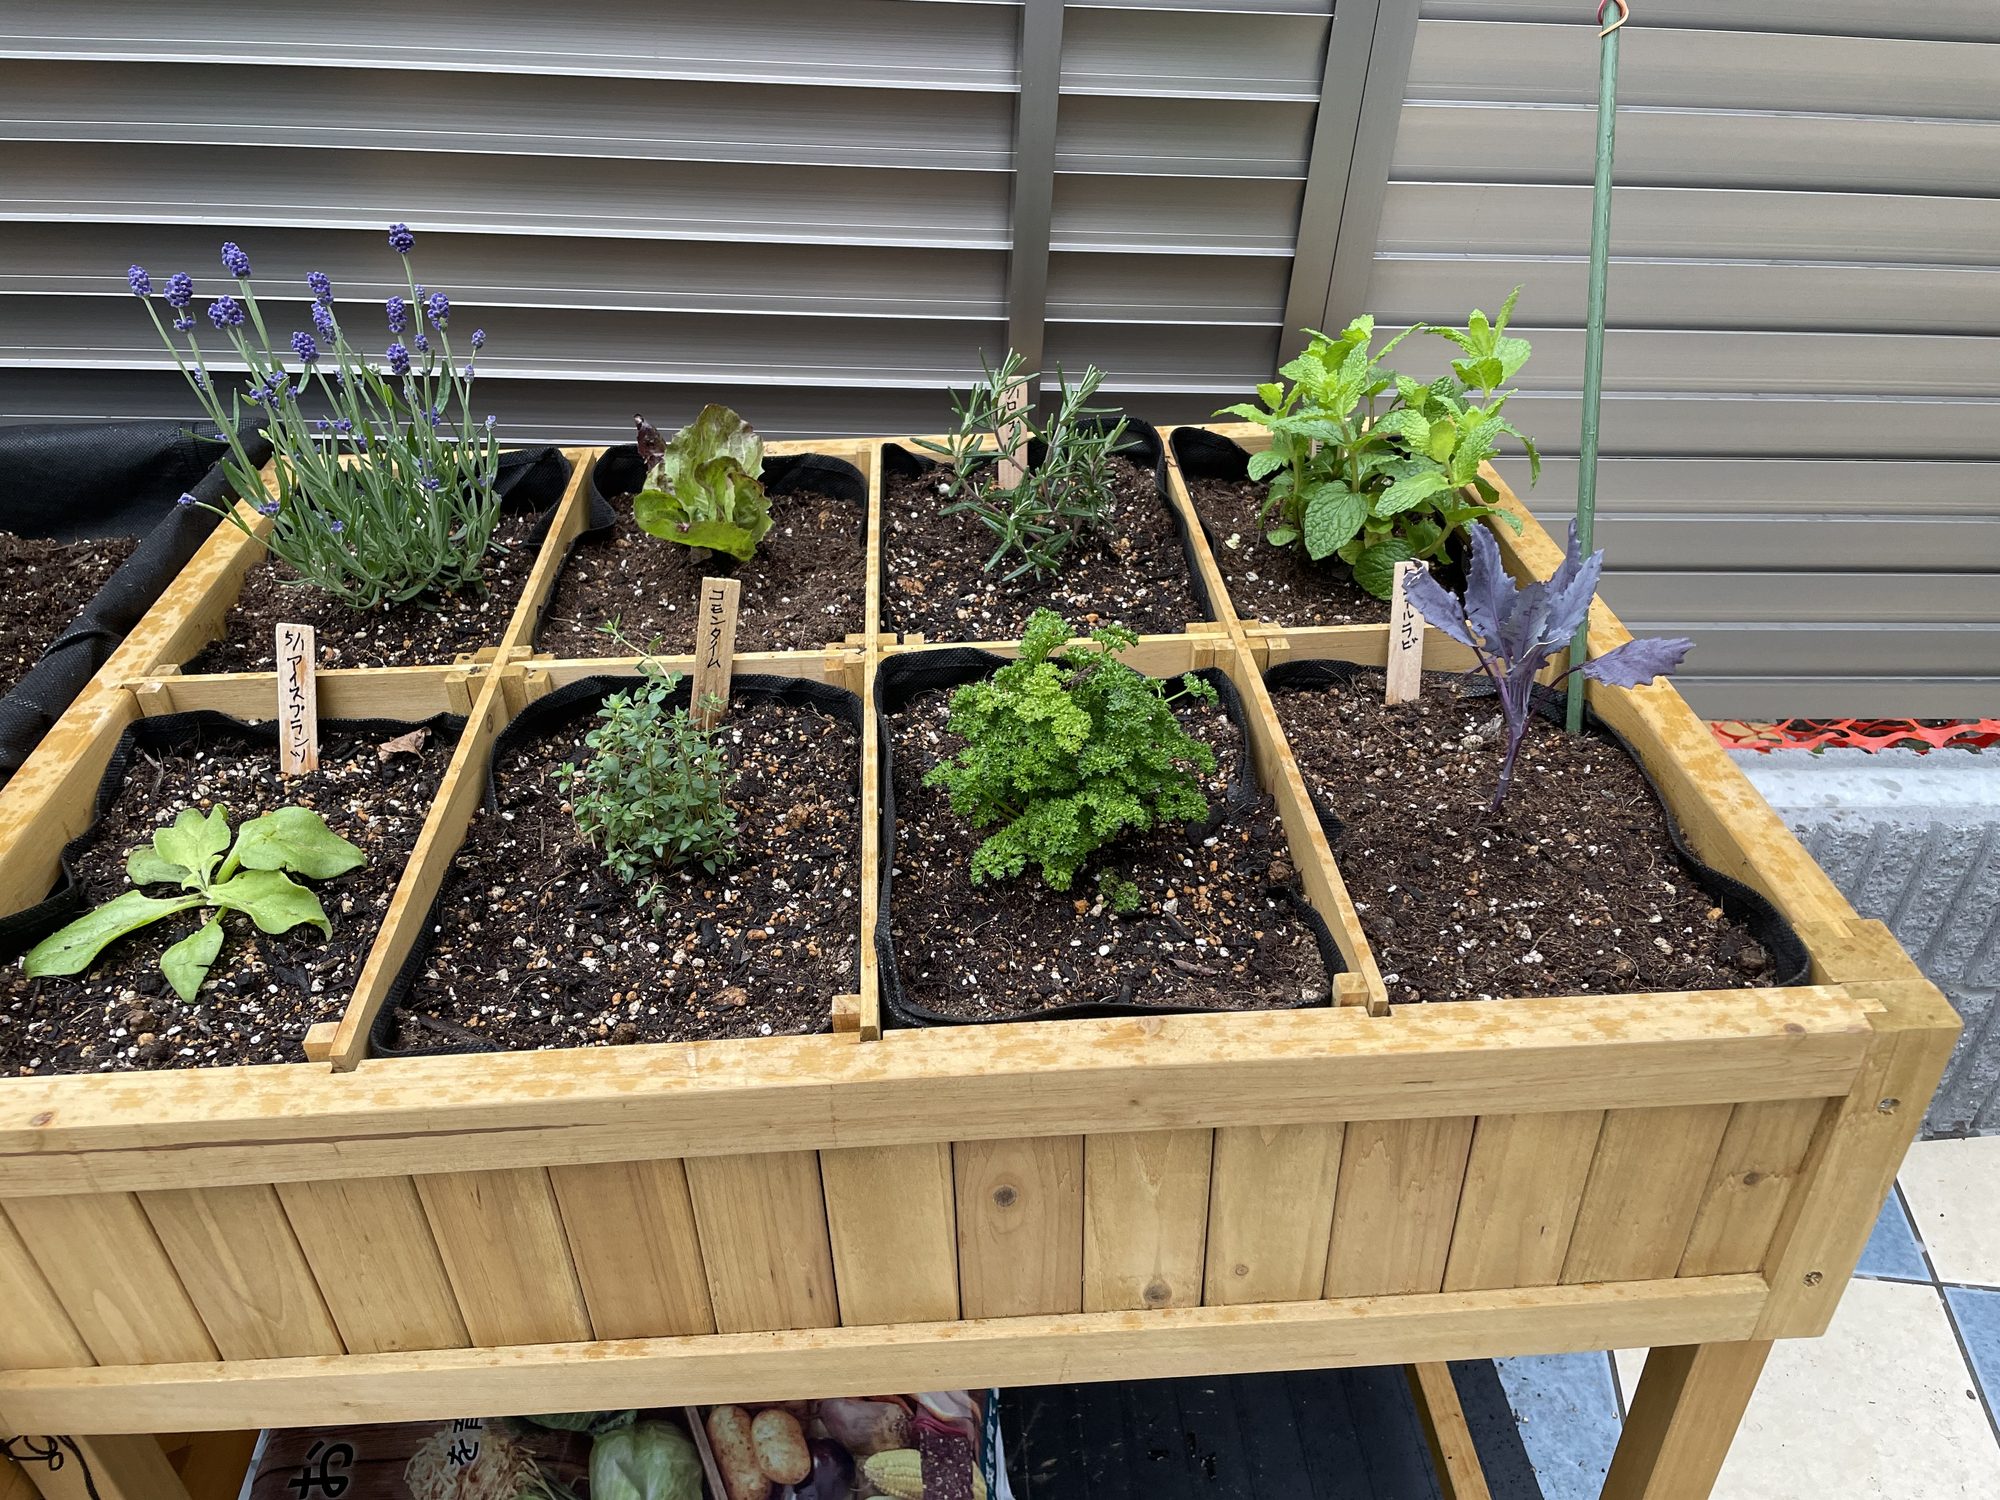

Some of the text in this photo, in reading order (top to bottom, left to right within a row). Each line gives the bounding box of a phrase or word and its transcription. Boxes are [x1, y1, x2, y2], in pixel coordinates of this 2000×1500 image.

[706, 591, 726, 668] コモンタイム
[1402, 592, 1418, 651] ールラビ
[287, 654, 309, 763] アイスプランツ
[287, 1440, 353, 1499] お
